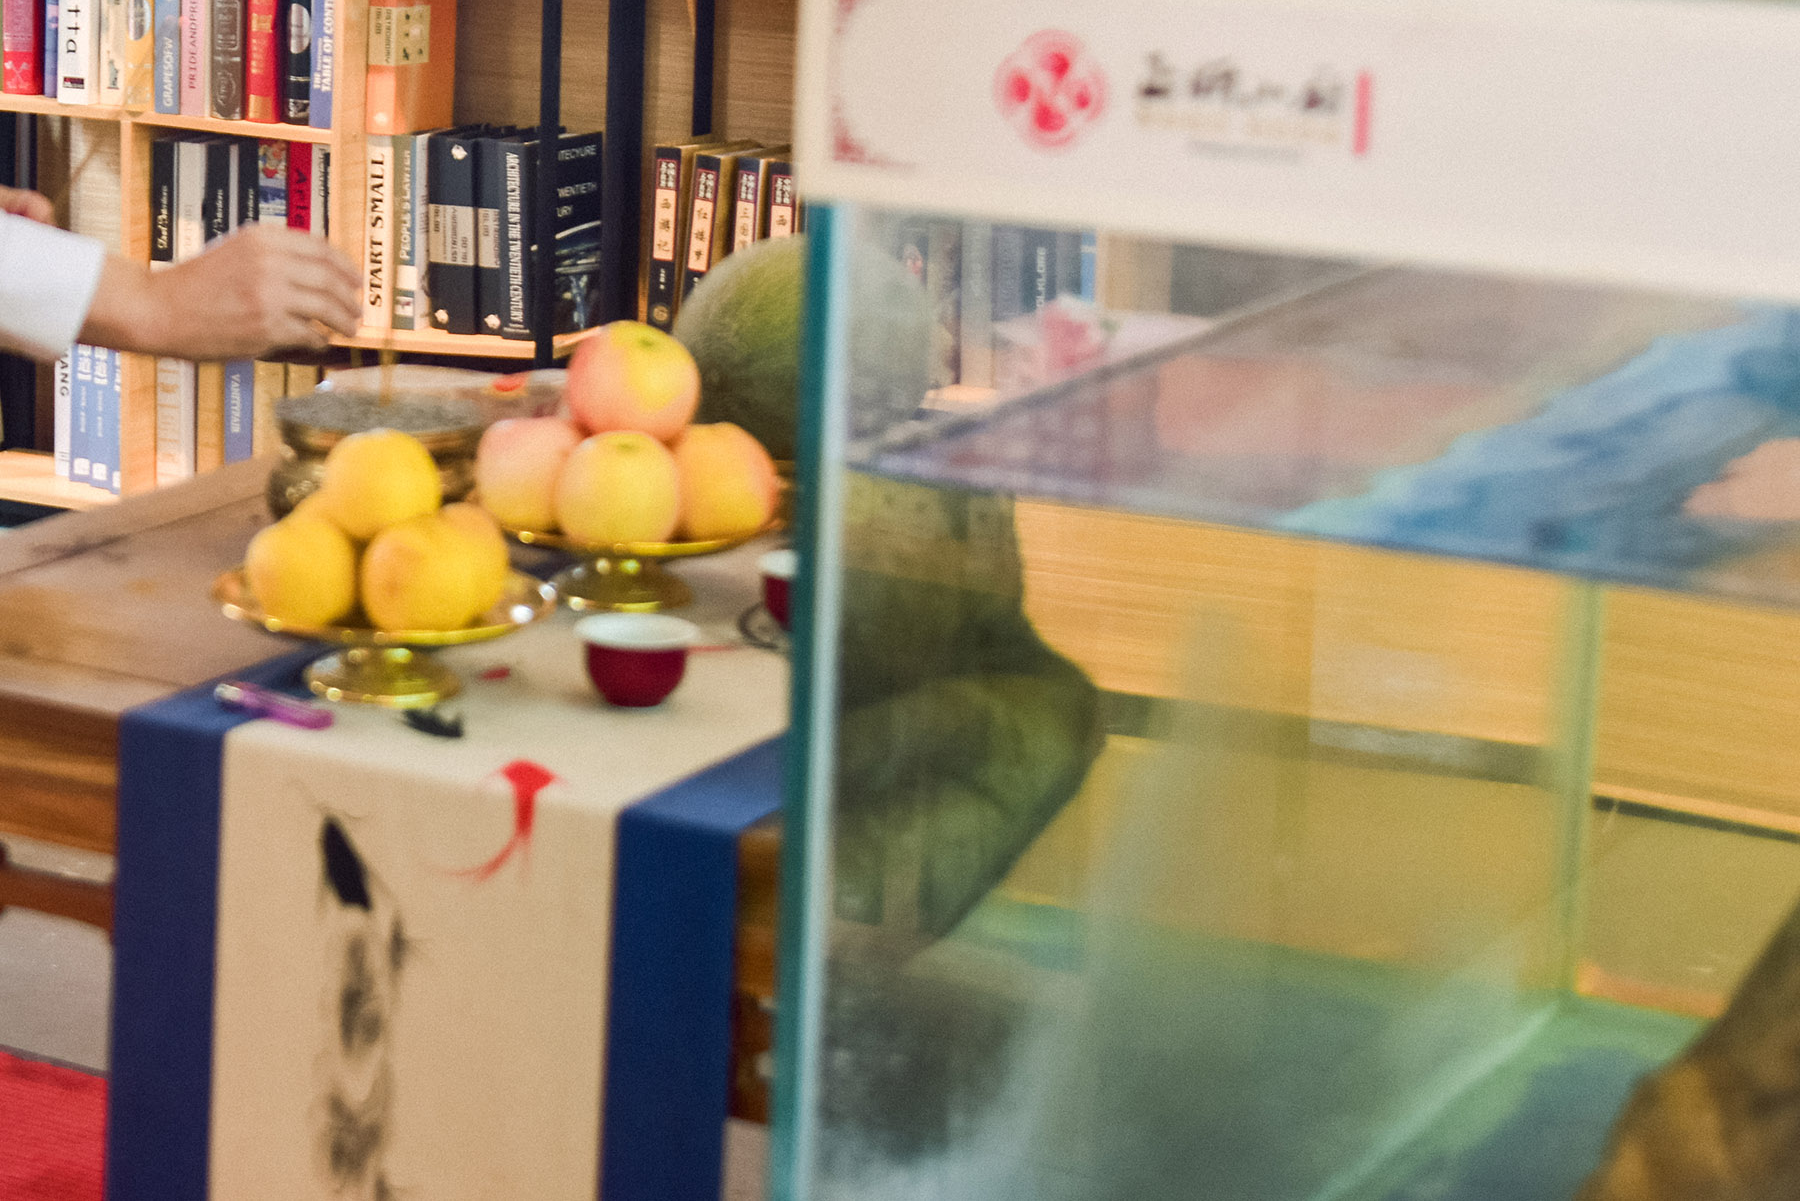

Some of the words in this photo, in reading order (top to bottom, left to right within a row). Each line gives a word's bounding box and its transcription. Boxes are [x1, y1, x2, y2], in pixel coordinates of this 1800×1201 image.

[322, 36, 333, 53] OF
[322, 55, 332, 92] TABLE
[369, 152, 385, 229] SMALL
[507, 223, 521, 239] THE
[368, 235, 384, 308] START
[508, 239, 523, 285] TWENTIETH
[509, 285, 524, 322] CENTURY
